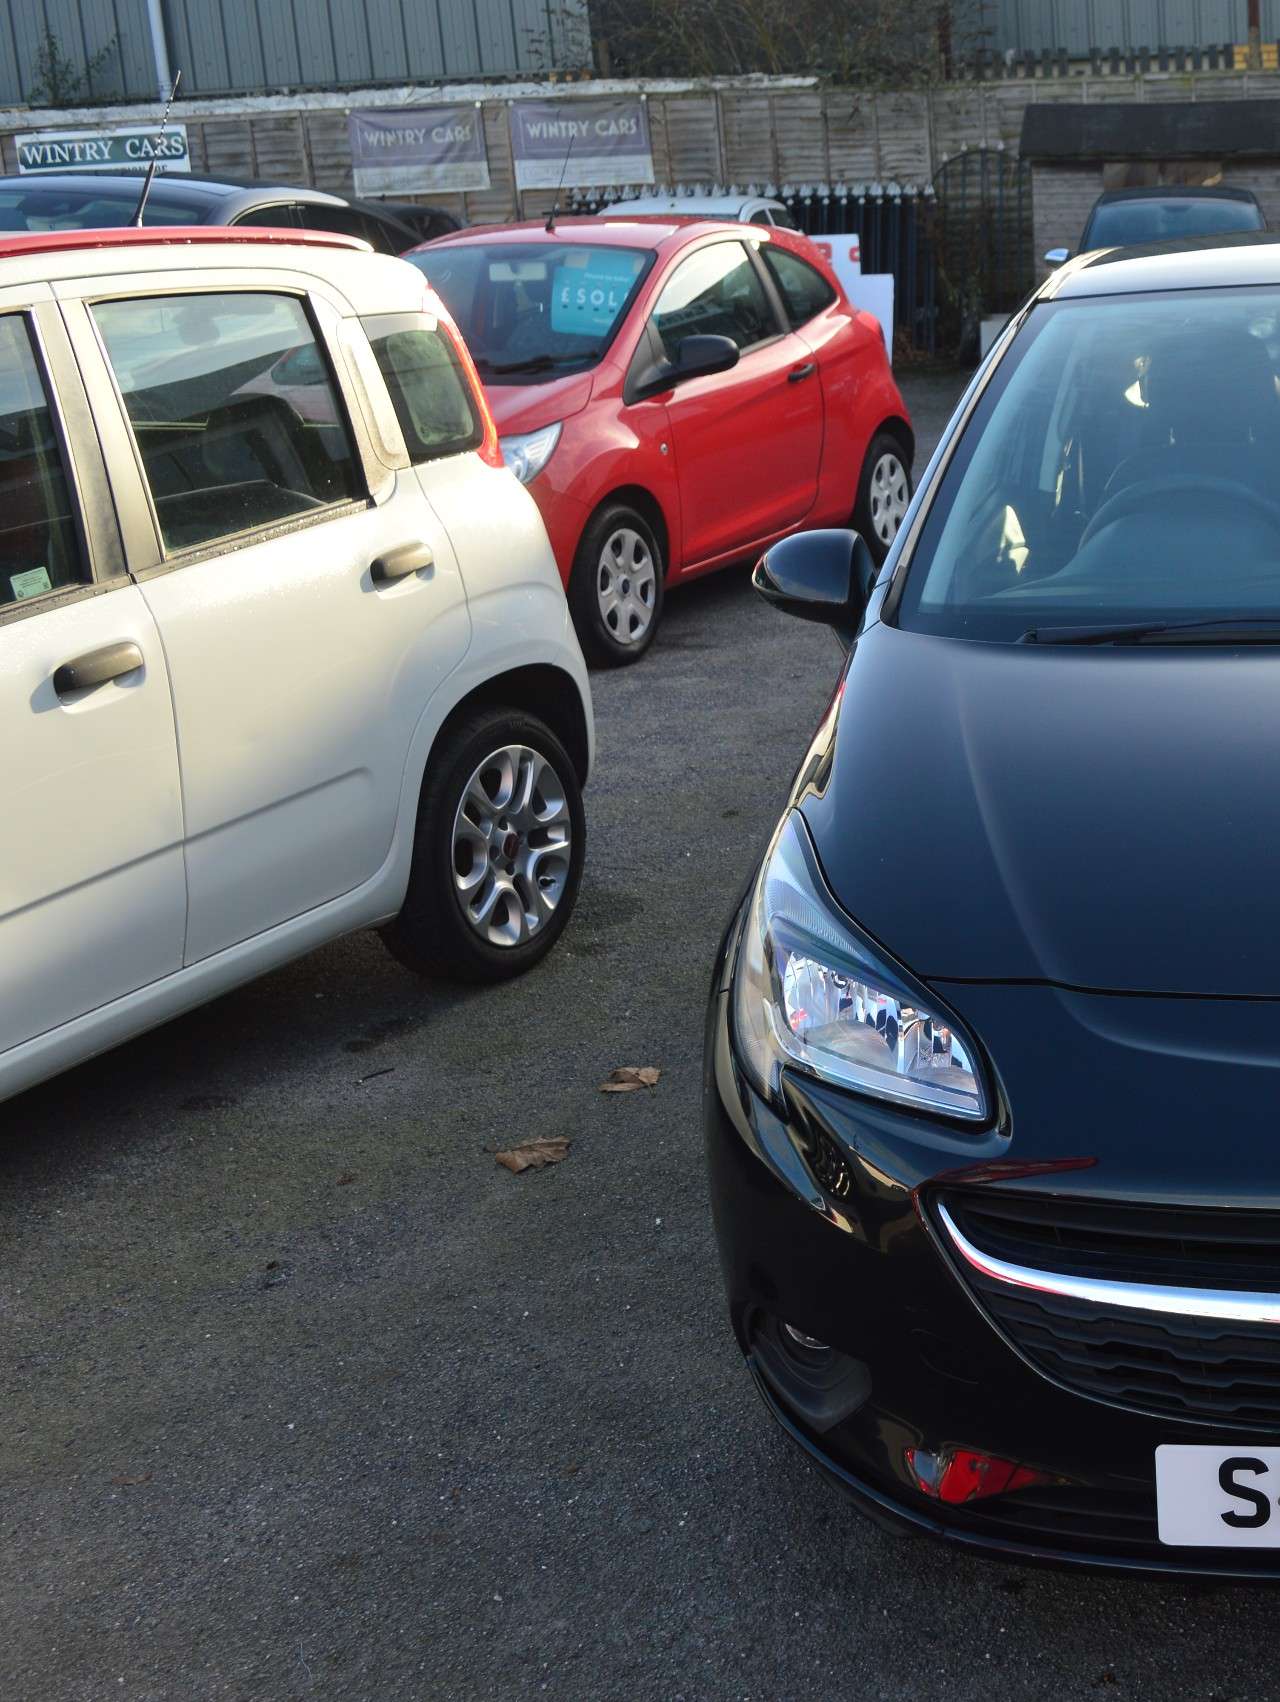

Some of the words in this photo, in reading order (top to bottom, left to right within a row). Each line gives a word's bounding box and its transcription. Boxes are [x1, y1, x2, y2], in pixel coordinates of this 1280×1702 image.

[364, 128, 426, 148] WINTRY
[431, 126, 472, 144] CARS
[526, 120, 590, 139] WINTRY
[594, 118, 637, 136] CARS
[23, 140, 113, 166] WINTRY
[125, 136, 184, 158] CARS
